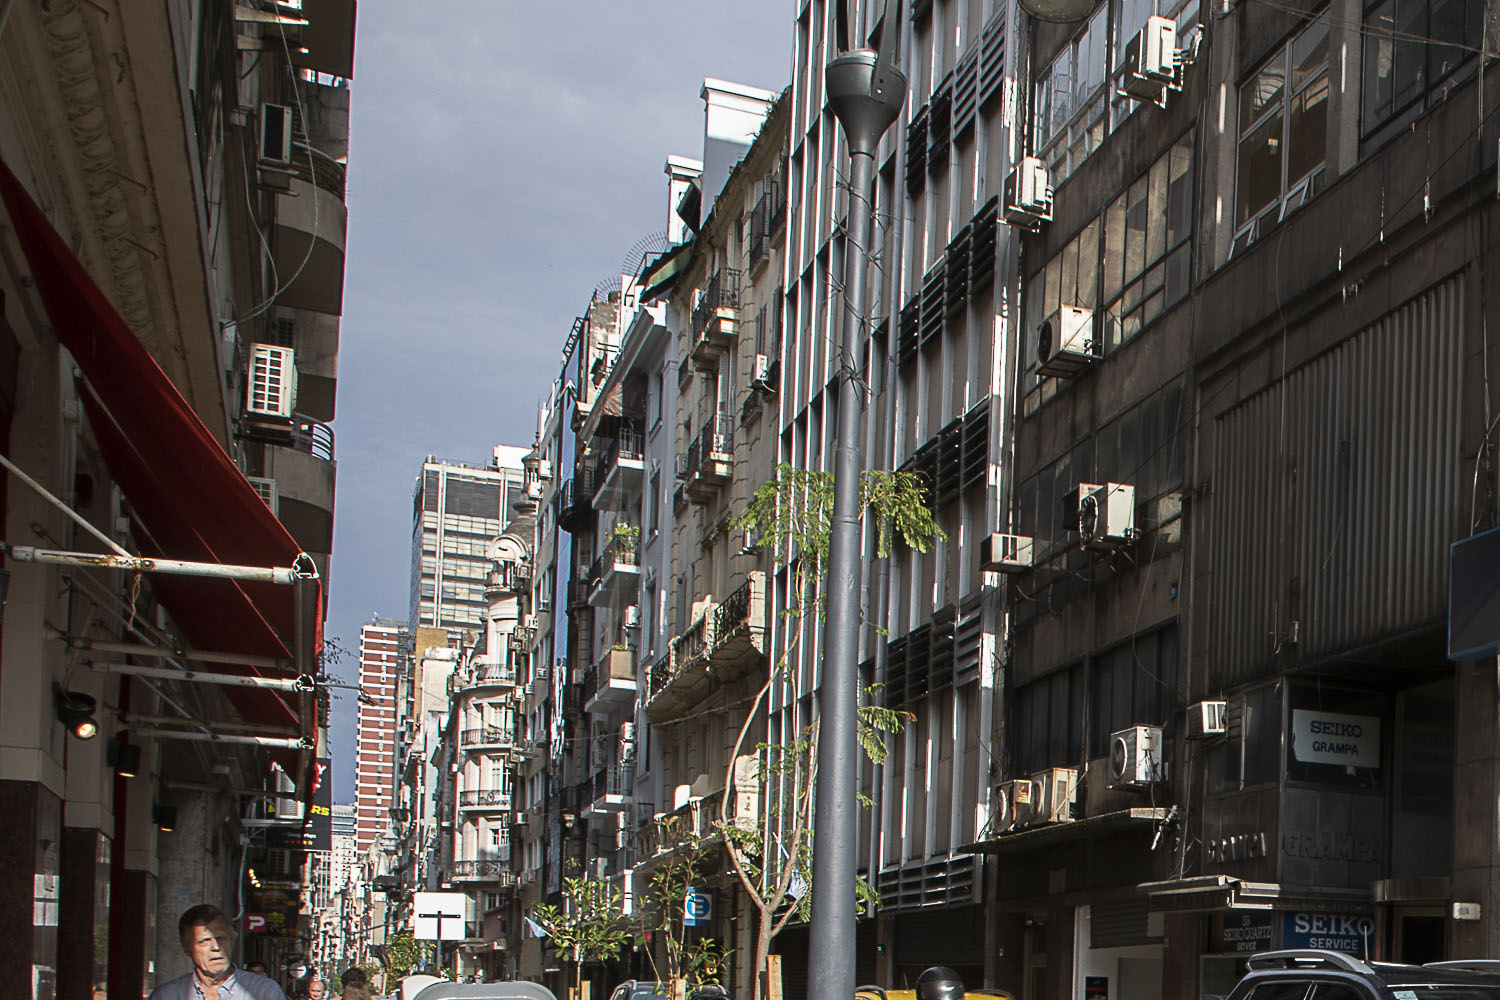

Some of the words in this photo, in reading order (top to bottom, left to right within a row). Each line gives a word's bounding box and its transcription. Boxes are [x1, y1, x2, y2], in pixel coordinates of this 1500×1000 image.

[1310, 719, 1363, 738] SEIKO
[1312, 740, 1359, 756] GRAMPA
[1294, 912, 1375, 936] SEIKO
[1309, 937, 1358, 950] SERVICE
